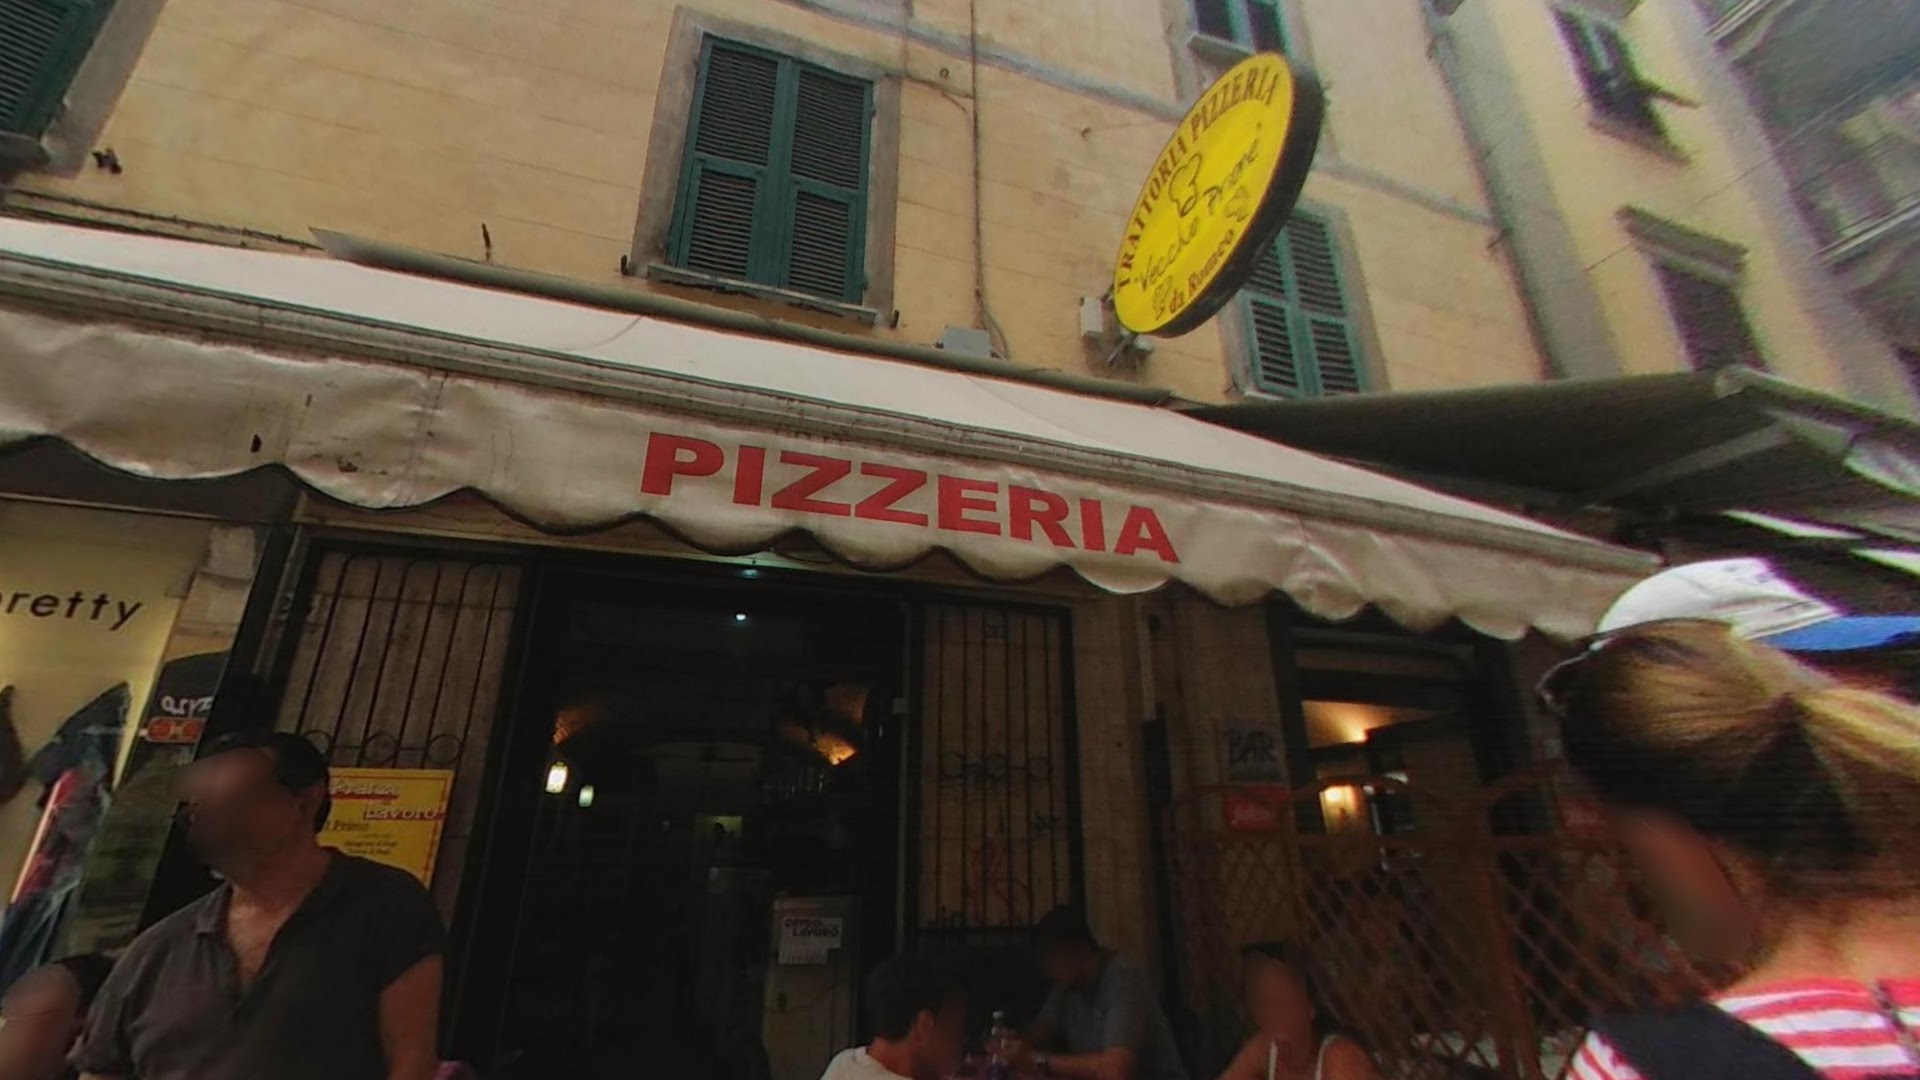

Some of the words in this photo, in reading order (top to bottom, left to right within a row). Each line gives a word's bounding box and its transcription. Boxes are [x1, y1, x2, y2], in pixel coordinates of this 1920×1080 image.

[1117, 135, 1188, 293] TRATTORIA
[1189, 65, 1280, 144] PIZZERIA
[640, 431, 1181, 564] PIZZERIA
[0, 591, 143, 631] retty
